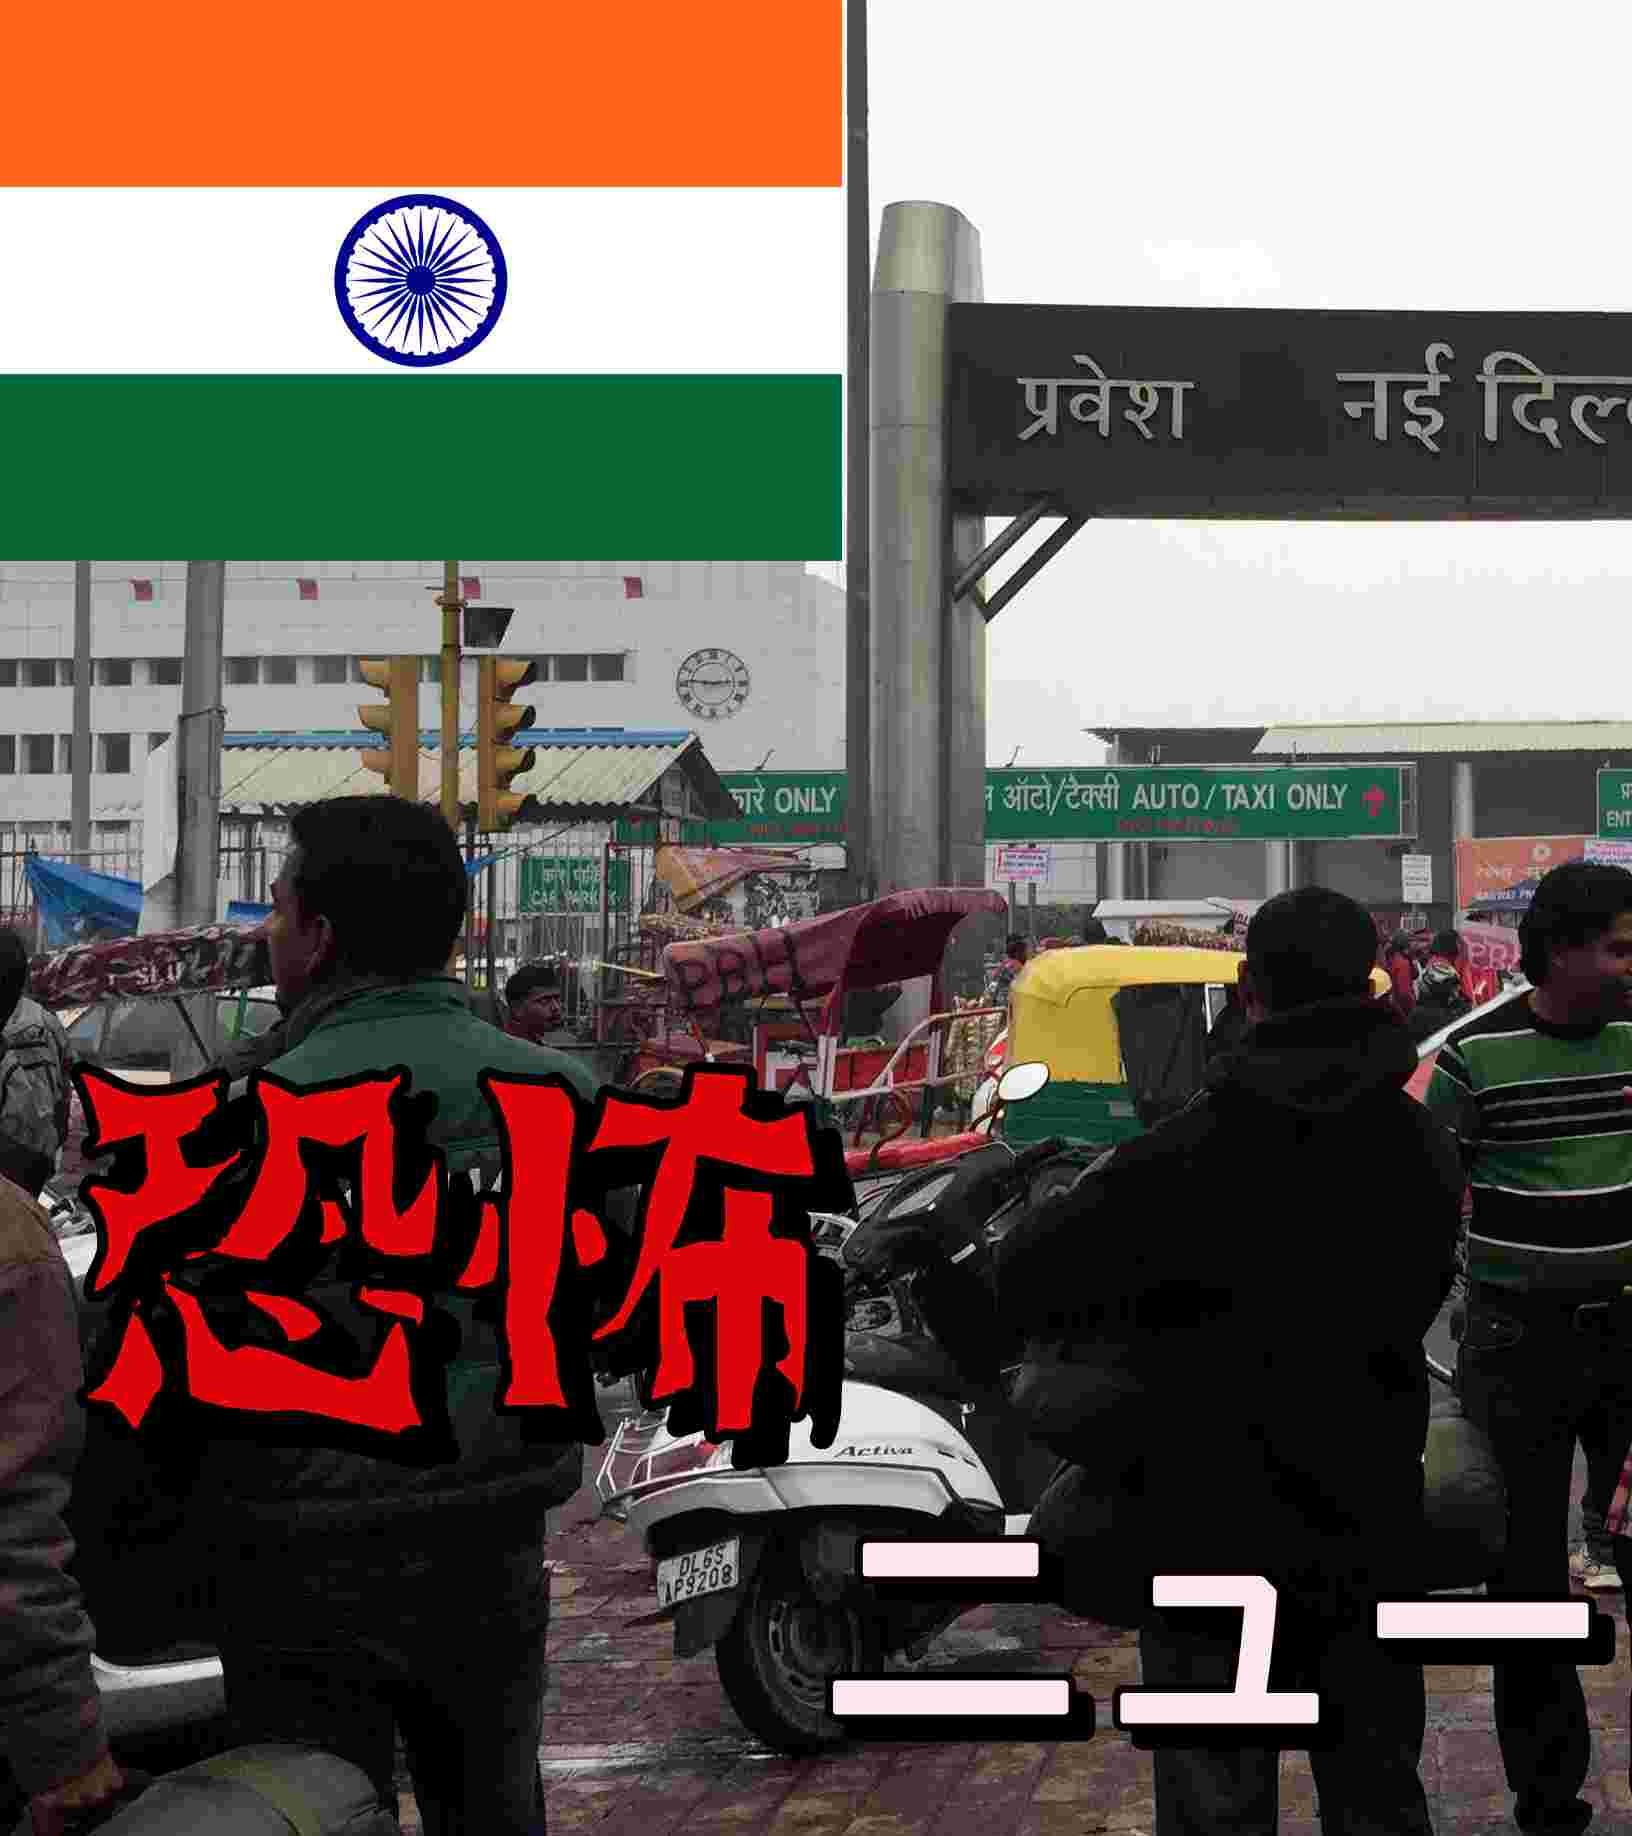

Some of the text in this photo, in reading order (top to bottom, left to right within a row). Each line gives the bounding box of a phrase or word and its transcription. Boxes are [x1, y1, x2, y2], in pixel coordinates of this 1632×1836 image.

[1016, 354, 1194, 443] प्रवेश
[1336, 342, 1455, 453] नई
[774, 786, 837, 814] ONLY
[1287, 783, 1348, 811] ONLY
[833, 1444, 914, 1458] Activa
